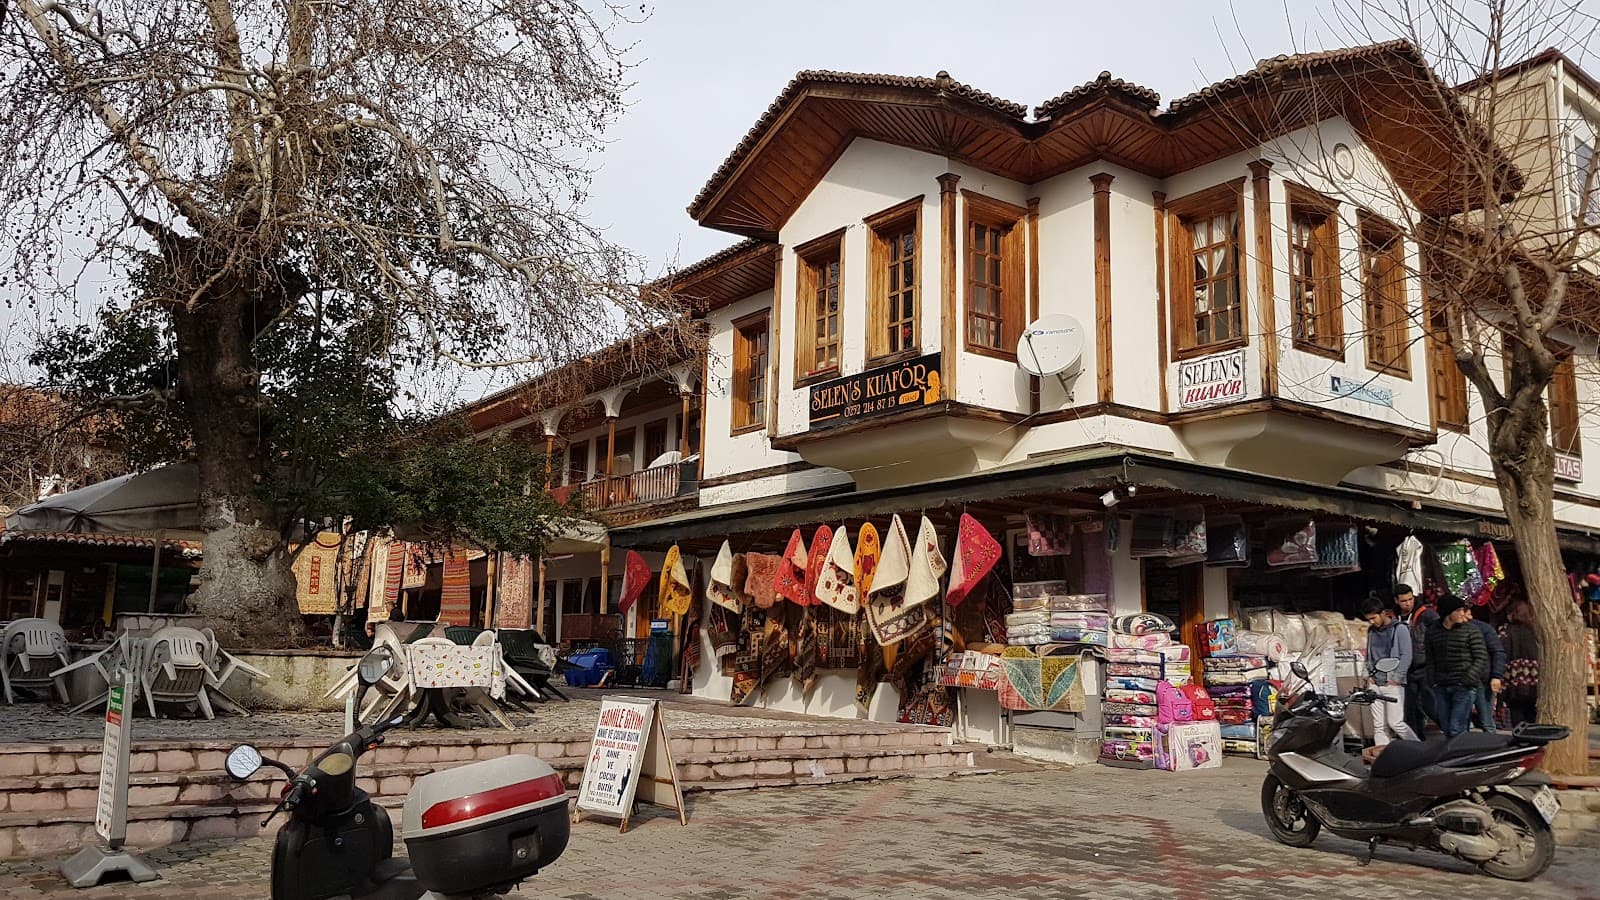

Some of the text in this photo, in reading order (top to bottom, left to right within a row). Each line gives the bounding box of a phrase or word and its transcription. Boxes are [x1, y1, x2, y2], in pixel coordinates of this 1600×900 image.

[1184, 355, 1241, 387] SELEN'S
[811, 362, 927, 411] SELEN'S KUAFÖR
[1184, 379, 1242, 403] KUAFÖR
[863, 401, 874, 413] 214
[876, 398, 886, 410] 87
[1554, 457, 1580, 477] LTAS
[606, 749, 620, 759] ANNE
[607, 760, 615, 770] VE
